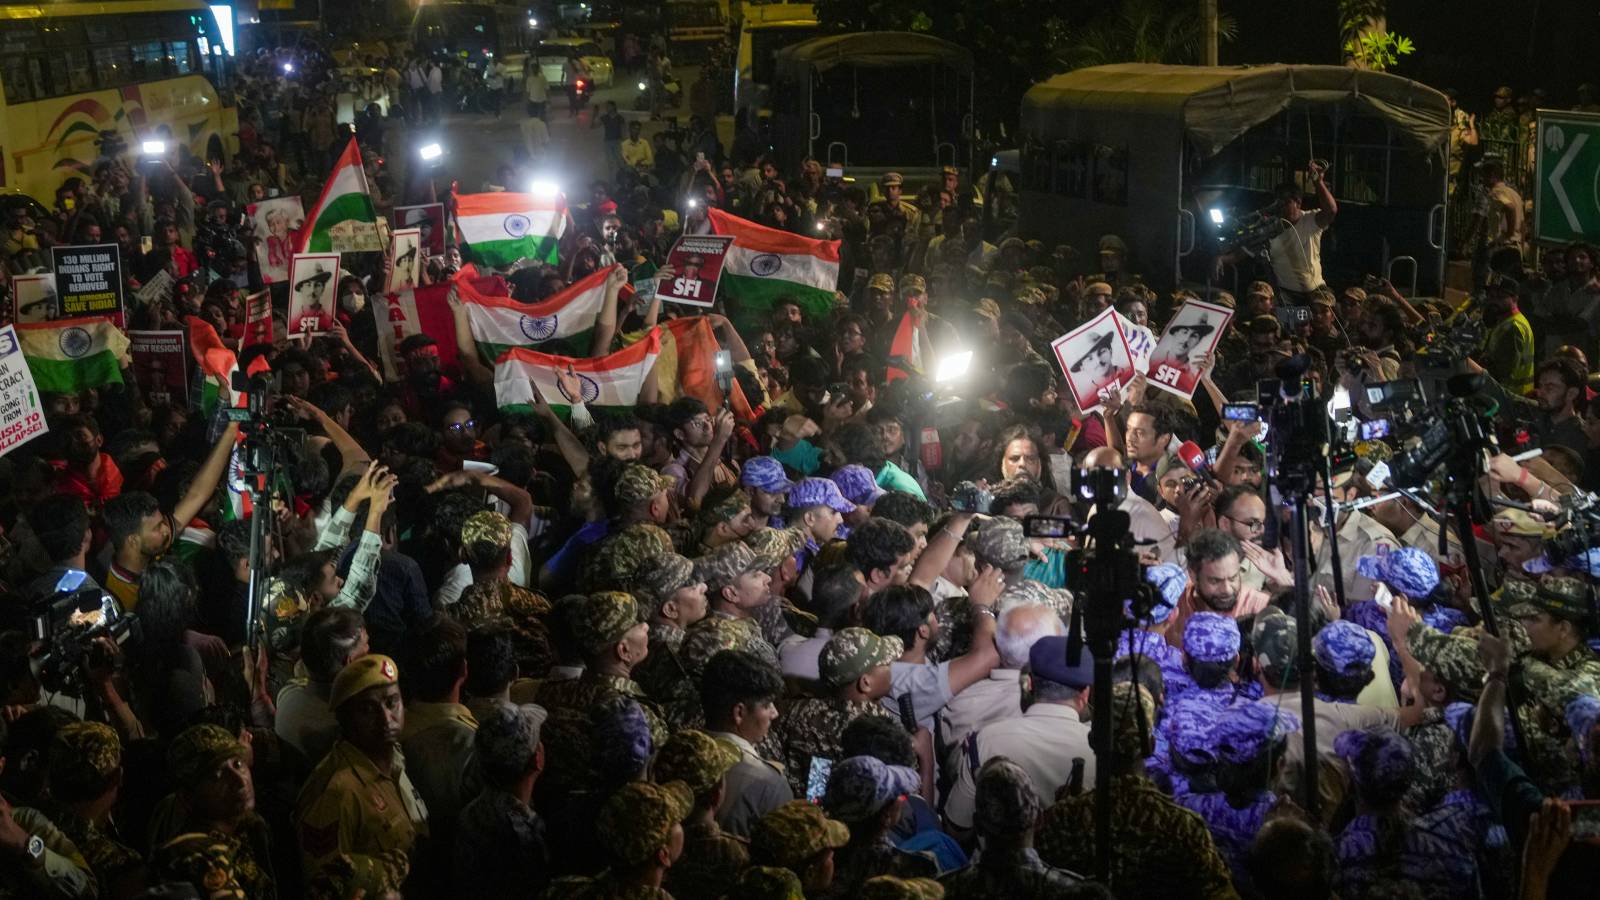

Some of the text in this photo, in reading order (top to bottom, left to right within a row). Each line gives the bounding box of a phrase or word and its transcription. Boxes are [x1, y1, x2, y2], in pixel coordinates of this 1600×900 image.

[62, 253, 111, 265] 130 MILLION
[58, 262, 116, 275] INDIANS RIGHT
[71, 272, 104, 284] TO VOTE
[68, 281, 109, 293] REMOVED!
[672, 277, 703, 298] SFI
[64, 299, 117, 313] SAVE INDIA!
[300, 316, 320, 332] SFI
[1154, 363, 1181, 387] SFI
[3, 391, 10, 401] IS
[1, 397, 20, 414] GOING
[4, 408, 21, 424] FROM
[0, 412, 40, 441] ISIS TO
